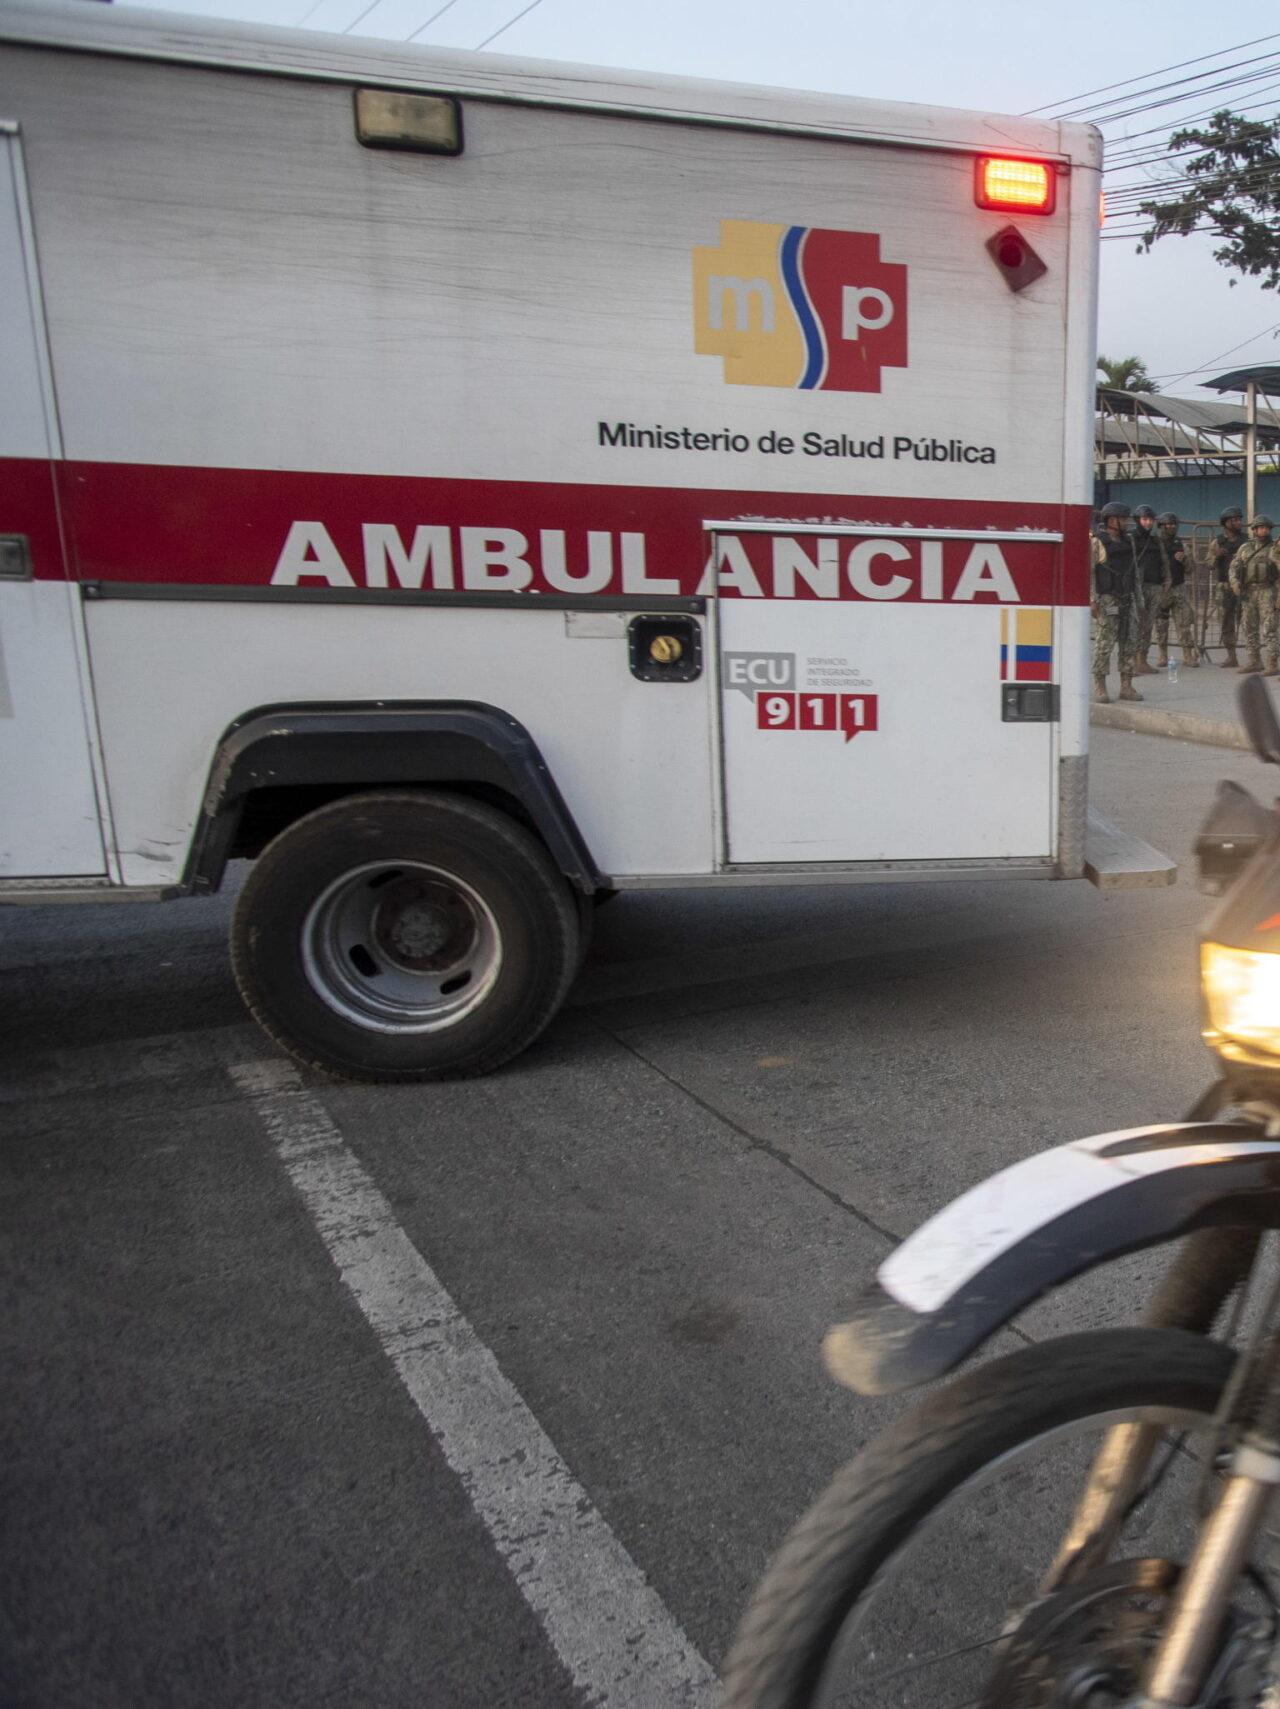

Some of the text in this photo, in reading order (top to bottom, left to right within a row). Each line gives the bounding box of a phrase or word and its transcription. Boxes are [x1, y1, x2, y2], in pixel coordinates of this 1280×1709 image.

[598, 421, 996, 464] Ministerio de Salud Pública
[269, 519, 1022, 603] AMBULANCIA
[729, 658, 791, 685] ECU
[806, 656, 849, 666] SERVICIO
[806, 667, 861, 677] INTEGRADO
[806, 678, 875, 688] DE SEGURIDAD
[765, 696, 865, 727] 911
